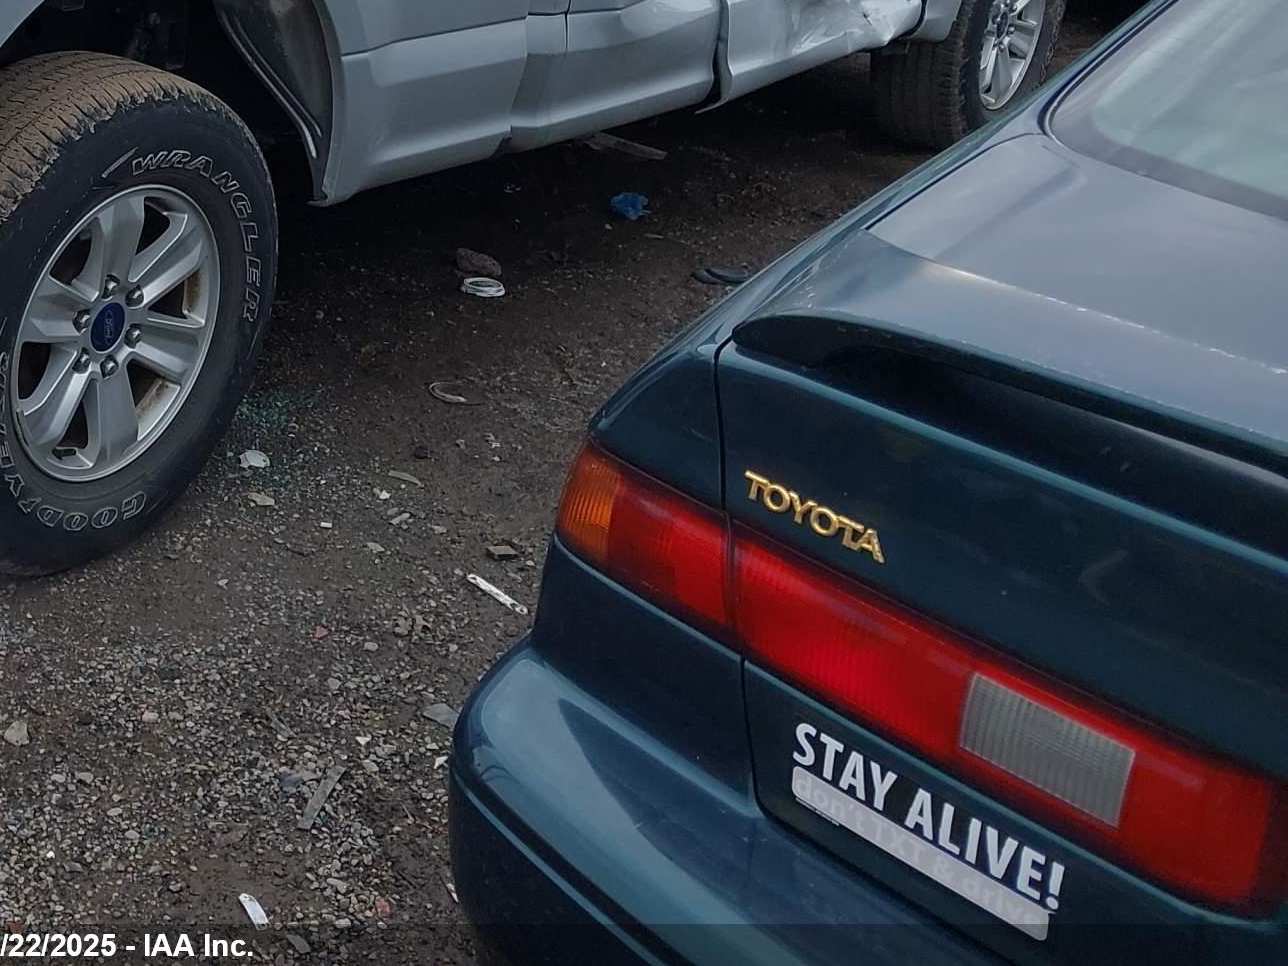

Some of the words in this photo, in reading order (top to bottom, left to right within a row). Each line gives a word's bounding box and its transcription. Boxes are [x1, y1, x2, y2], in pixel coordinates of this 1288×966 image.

[132, 147, 264, 322] WRANGLER
[744, 469, 886, 564] TOYOTA
[792, 722, 898, 811] STAY
[904, 789, 1065, 911] ALIVE!
[795, 776, 866, 835] don't
[869, 816, 923, 864] TXT
[932, 855, 954, 878] &
[960, 876, 1042, 926] drive
